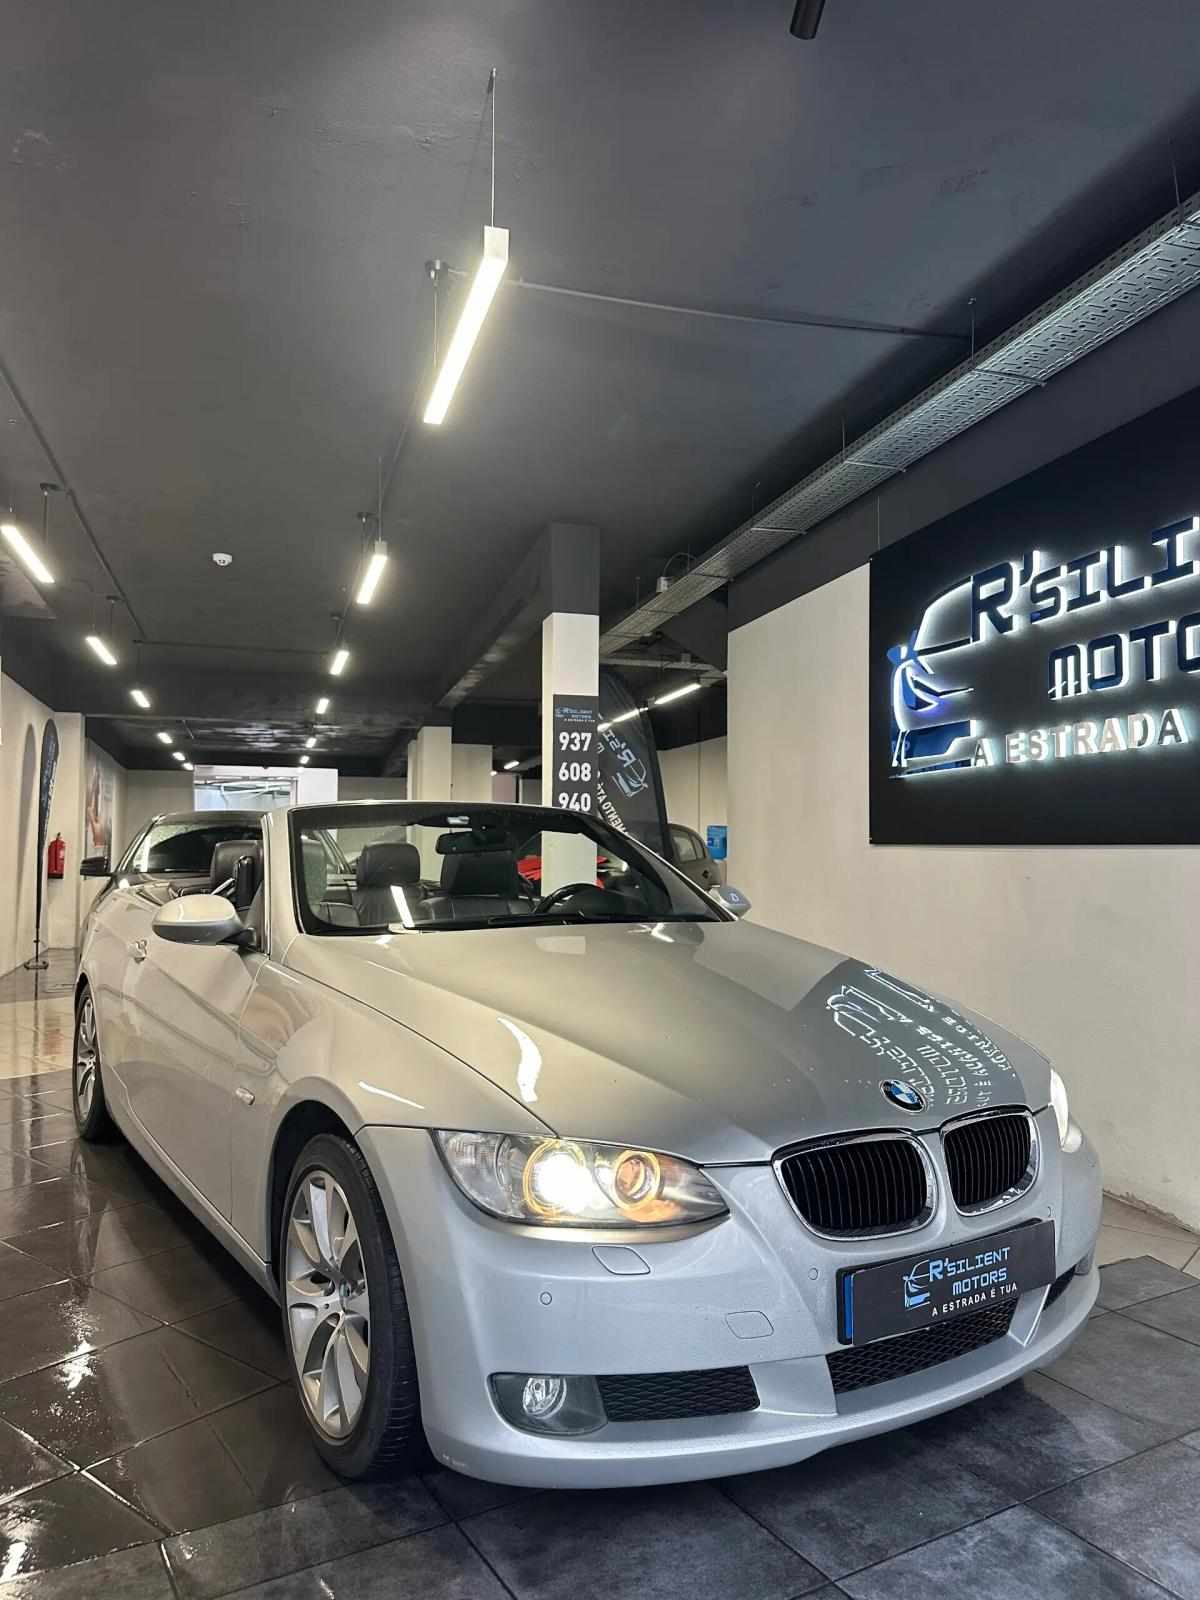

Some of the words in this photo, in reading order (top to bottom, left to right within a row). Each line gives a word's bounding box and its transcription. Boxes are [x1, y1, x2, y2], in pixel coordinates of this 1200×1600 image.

[559, 731, 592, 751] 937
[971, 736, 995, 768] A
[1005, 708, 1189, 765] ESTRADA
[558, 762, 592, 782] 608
[558, 792, 591, 812] 940
[929, 1246, 1010, 1282] R'SILIENT
[952, 1267, 1007, 1296] MOTORS
[932, 1306, 938, 1317] A
[942, 1292, 987, 1313] ESTRADA
[1001, 1282, 1018, 1295] TUA
